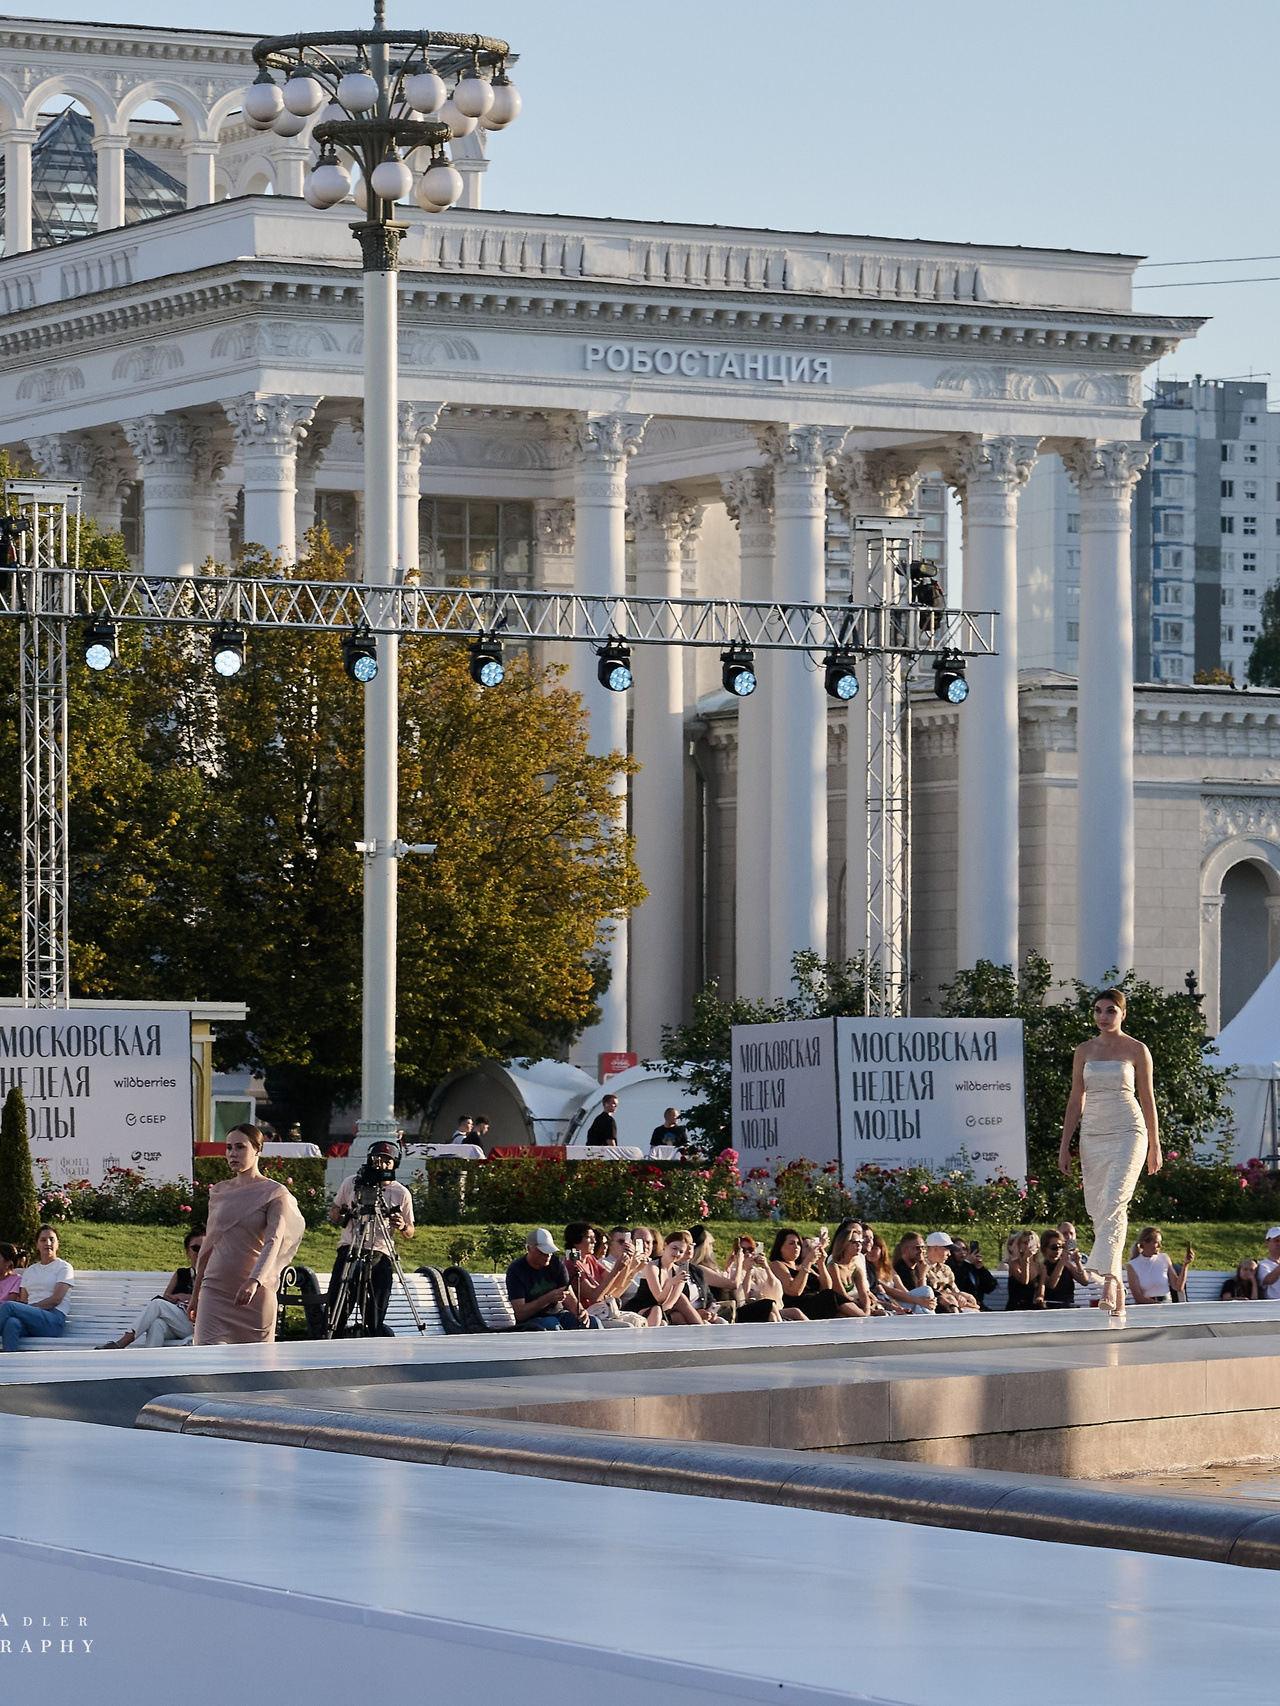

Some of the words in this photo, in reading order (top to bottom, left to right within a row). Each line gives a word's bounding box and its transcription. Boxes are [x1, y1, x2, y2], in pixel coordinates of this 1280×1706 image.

[585, 343, 832, 387] РОБОСТАНЦИЯ
[739, 1036, 820, 1074] МОСКОВСКАЯ
[851, 1030, 997, 1063] МОСКОВСКАЯ
[0, 1065, 90, 1101] НЕДЕЛЯ
[114, 1076, 176, 1088] wildberries
[740, 1078, 785, 1113] НЕДЕЛЯ
[852, 1070, 934, 1104] НЕДЕЛЯ
[955, 1080, 1011, 1091] wildberries
[1, 1106, 75, 1141] ОДЫ
[139, 1115, 166, 1124] СБЕР
[740, 1117, 779, 1151] МОДЫ
[853, 1109, 921, 1142] МОДЫ
[978, 1117, 1002, 1125] СБЕР
